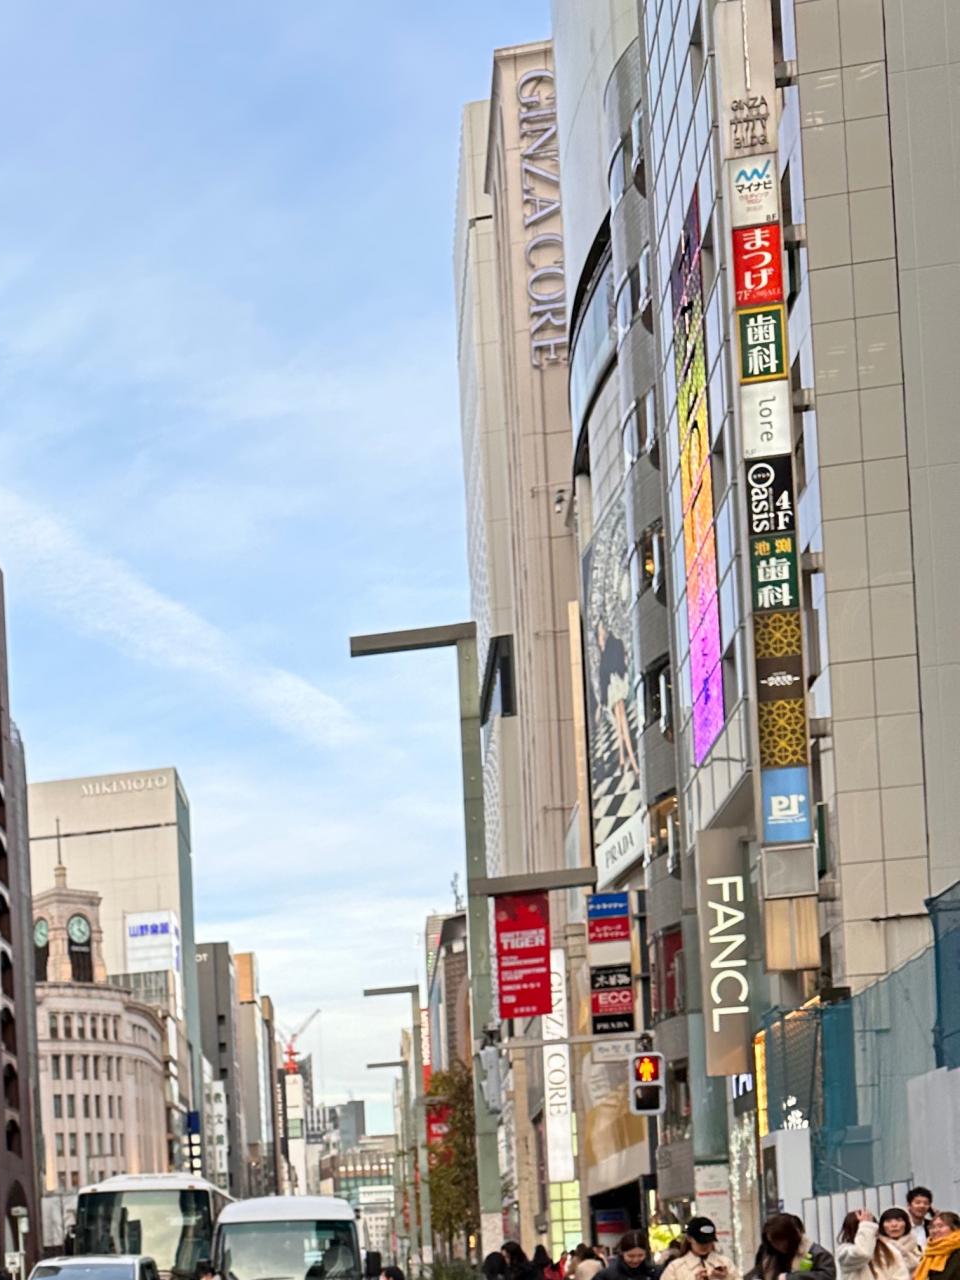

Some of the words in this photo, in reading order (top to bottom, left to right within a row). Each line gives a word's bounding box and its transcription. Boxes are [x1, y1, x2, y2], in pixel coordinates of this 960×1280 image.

[516, 68, 562, 229] GINZA
[736, 181, 772, 195] マイナビ
[742, 228, 773, 290] まつげ
[525, 231, 571, 369] CORE
[737, 289, 752, 301] 7F
[746, 314, 778, 375] 歯科
[759, 396, 776, 443] lore
[748, 463, 775, 533] Oasis
[776, 490, 793, 530] 4F
[757, 557, 793, 608] 歯科
[81, 776, 167, 795] MIKIMOTO
[605, 831, 635, 869] PRADA
[502, 936, 546, 951] TIGER
[707, 875, 749, 1032] FANCL
[598, 990, 631, 1005] ECC
[547, 1052, 568, 1117] CORE
